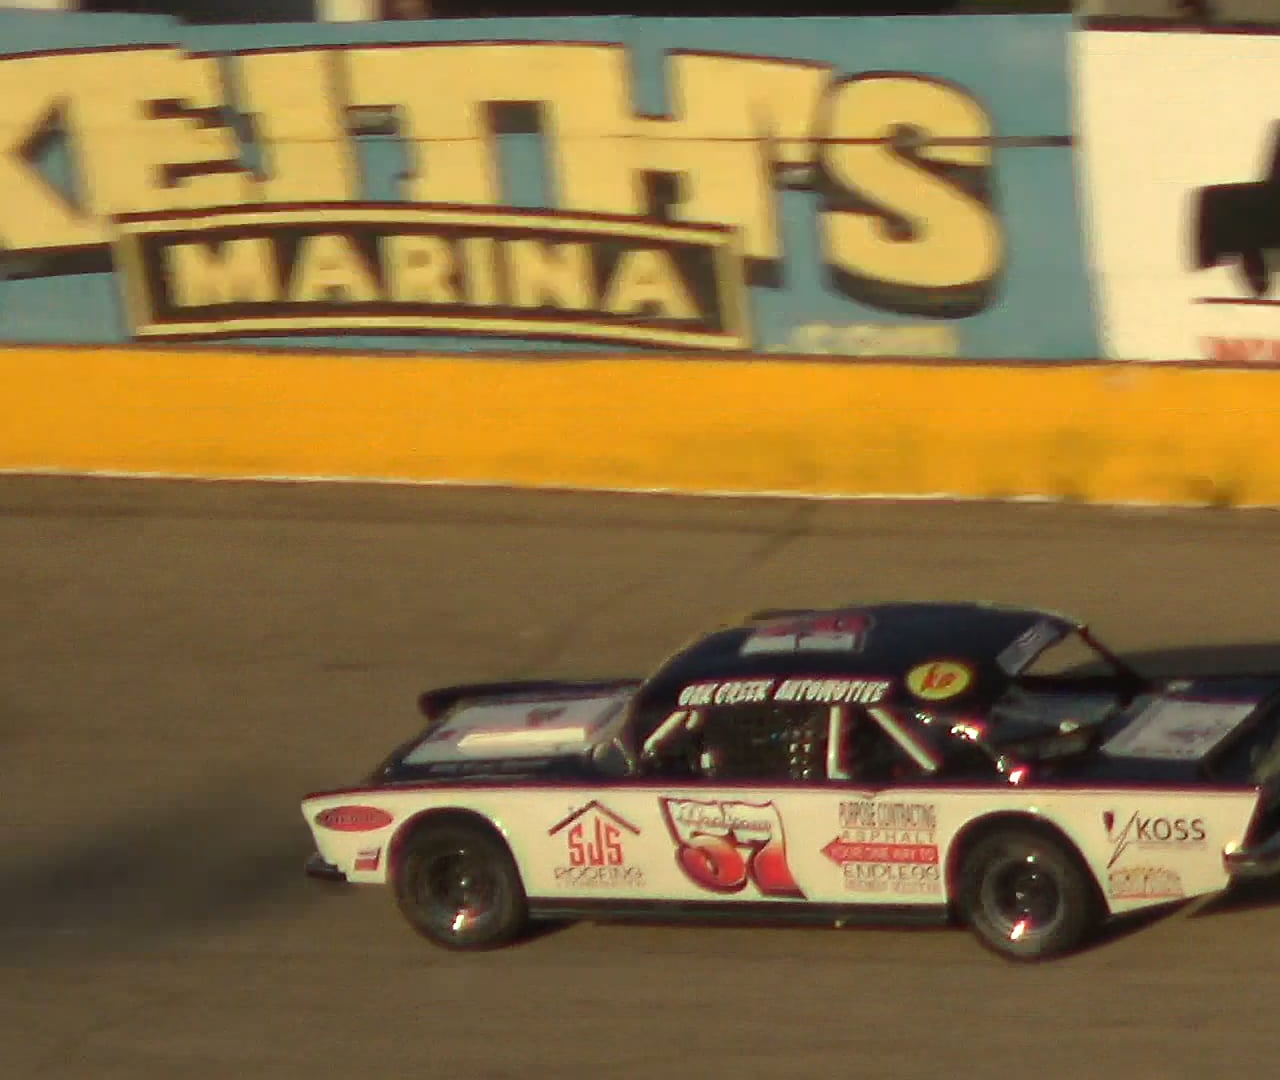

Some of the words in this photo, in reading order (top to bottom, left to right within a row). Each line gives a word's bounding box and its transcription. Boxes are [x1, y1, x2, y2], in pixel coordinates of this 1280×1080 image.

[158, 234, 702, 322] MARINA
[715, 678, 775, 704] CREEK
[774, 679, 891, 704] AUTOMOTIVE
[568, 815, 625, 868] SJS
[841, 829, 936, 843] ASPHALT
[1136, 817, 1207, 841] KOSS
[658, 796, 809, 901] 57
[843, 864, 940, 881] ENDLESS
